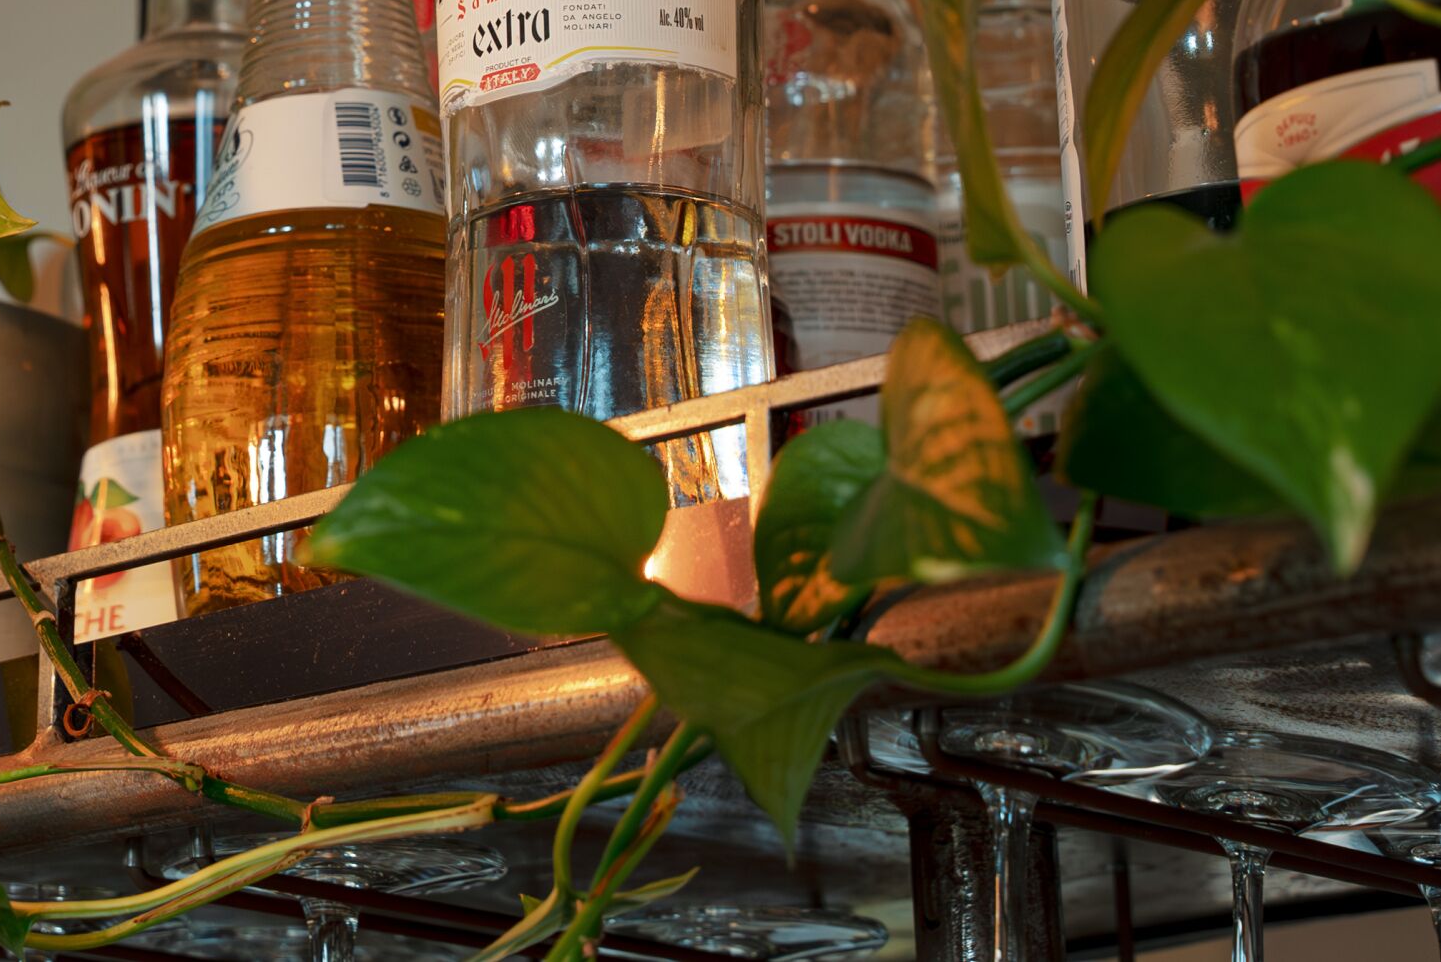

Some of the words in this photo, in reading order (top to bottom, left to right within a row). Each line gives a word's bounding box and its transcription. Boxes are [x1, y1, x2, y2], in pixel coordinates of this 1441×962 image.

[562, 3, 606, 11] FONDATI
[563, 14, 576, 22] DA
[582, 13, 622, 21] ANGELO
[659, 8, 672, 27] Alc.
[673, 6, 693, 30] 40%
[694, 14, 704, 32] vol
[472, 6, 550, 59] extra
[563, 23, 613, 31] MOLINARI
[485, 59, 519, 73] PRODUCT
[521, 56, 533, 64] OF
[484, 67, 531, 91] ITALY
[773, 221, 841, 247] STOLI
[843, 223, 913, 253] VODKA
[504, 389, 557, 404] ORIGINALE
